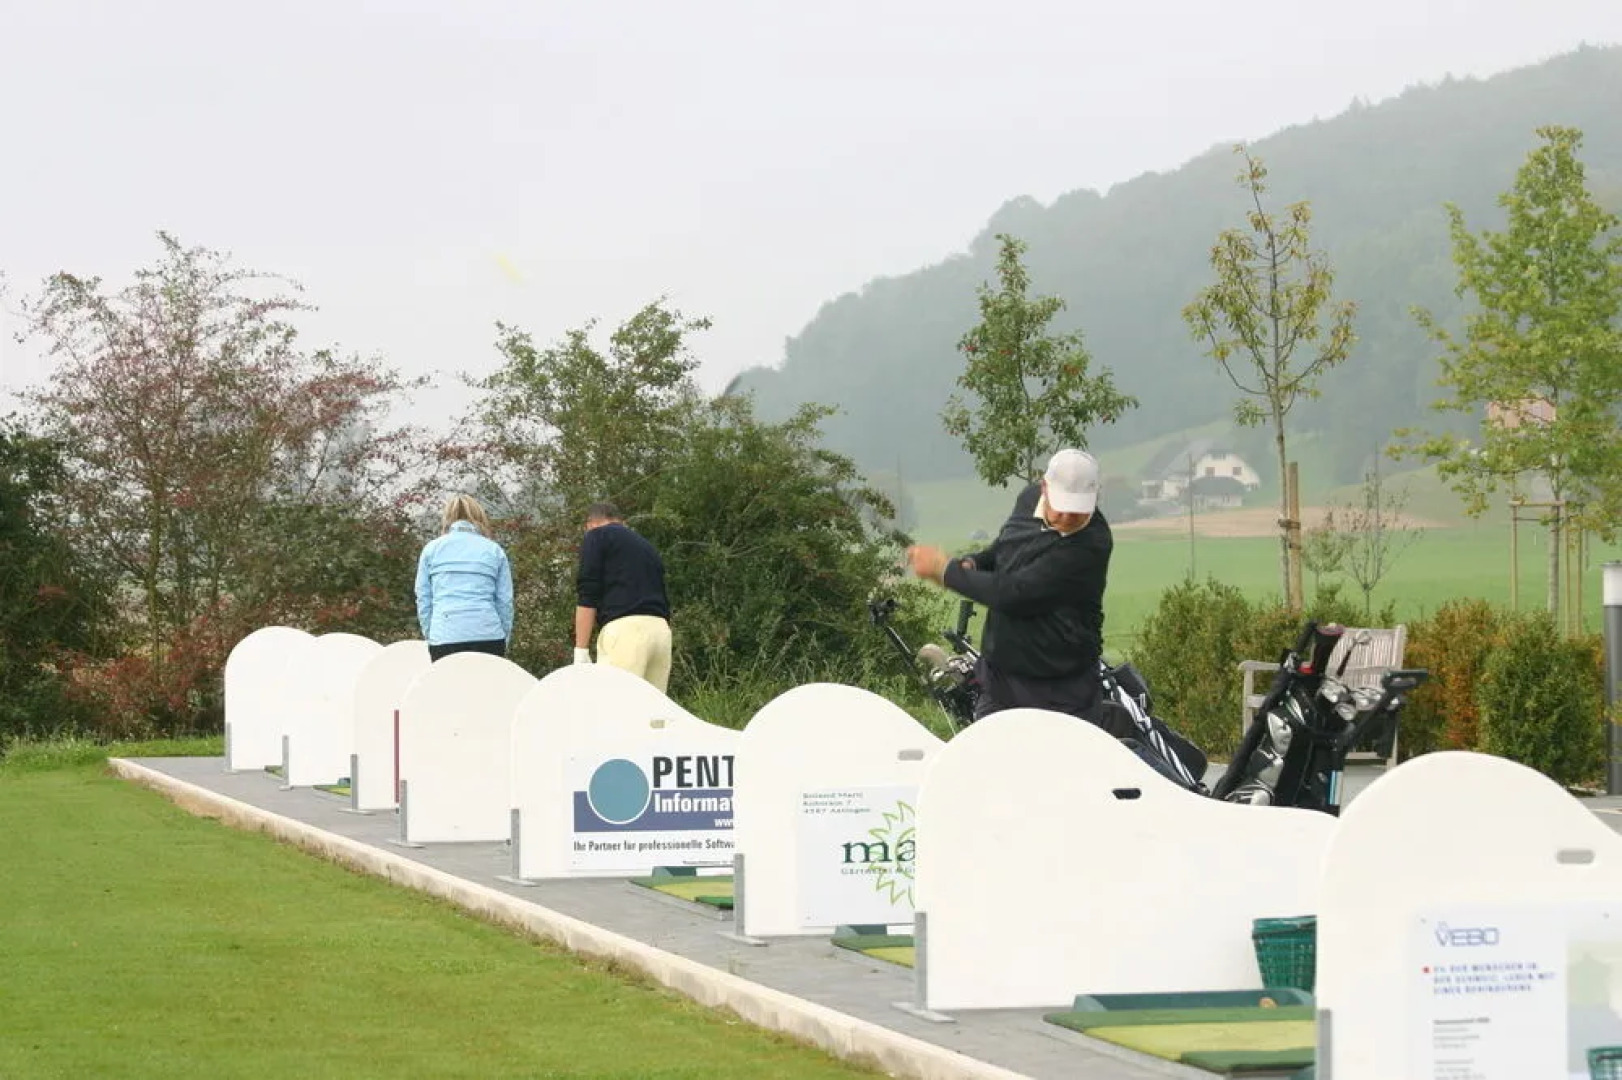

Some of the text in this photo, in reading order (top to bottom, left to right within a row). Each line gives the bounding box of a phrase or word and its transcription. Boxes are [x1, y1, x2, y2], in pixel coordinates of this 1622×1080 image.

[653, 755, 734, 788] PENT
[654, 793, 733, 813] Informa
[573, 841, 586, 852] Ihr
[588, 841, 620, 852] Partner
[638, 839, 702, 853] professionelle
